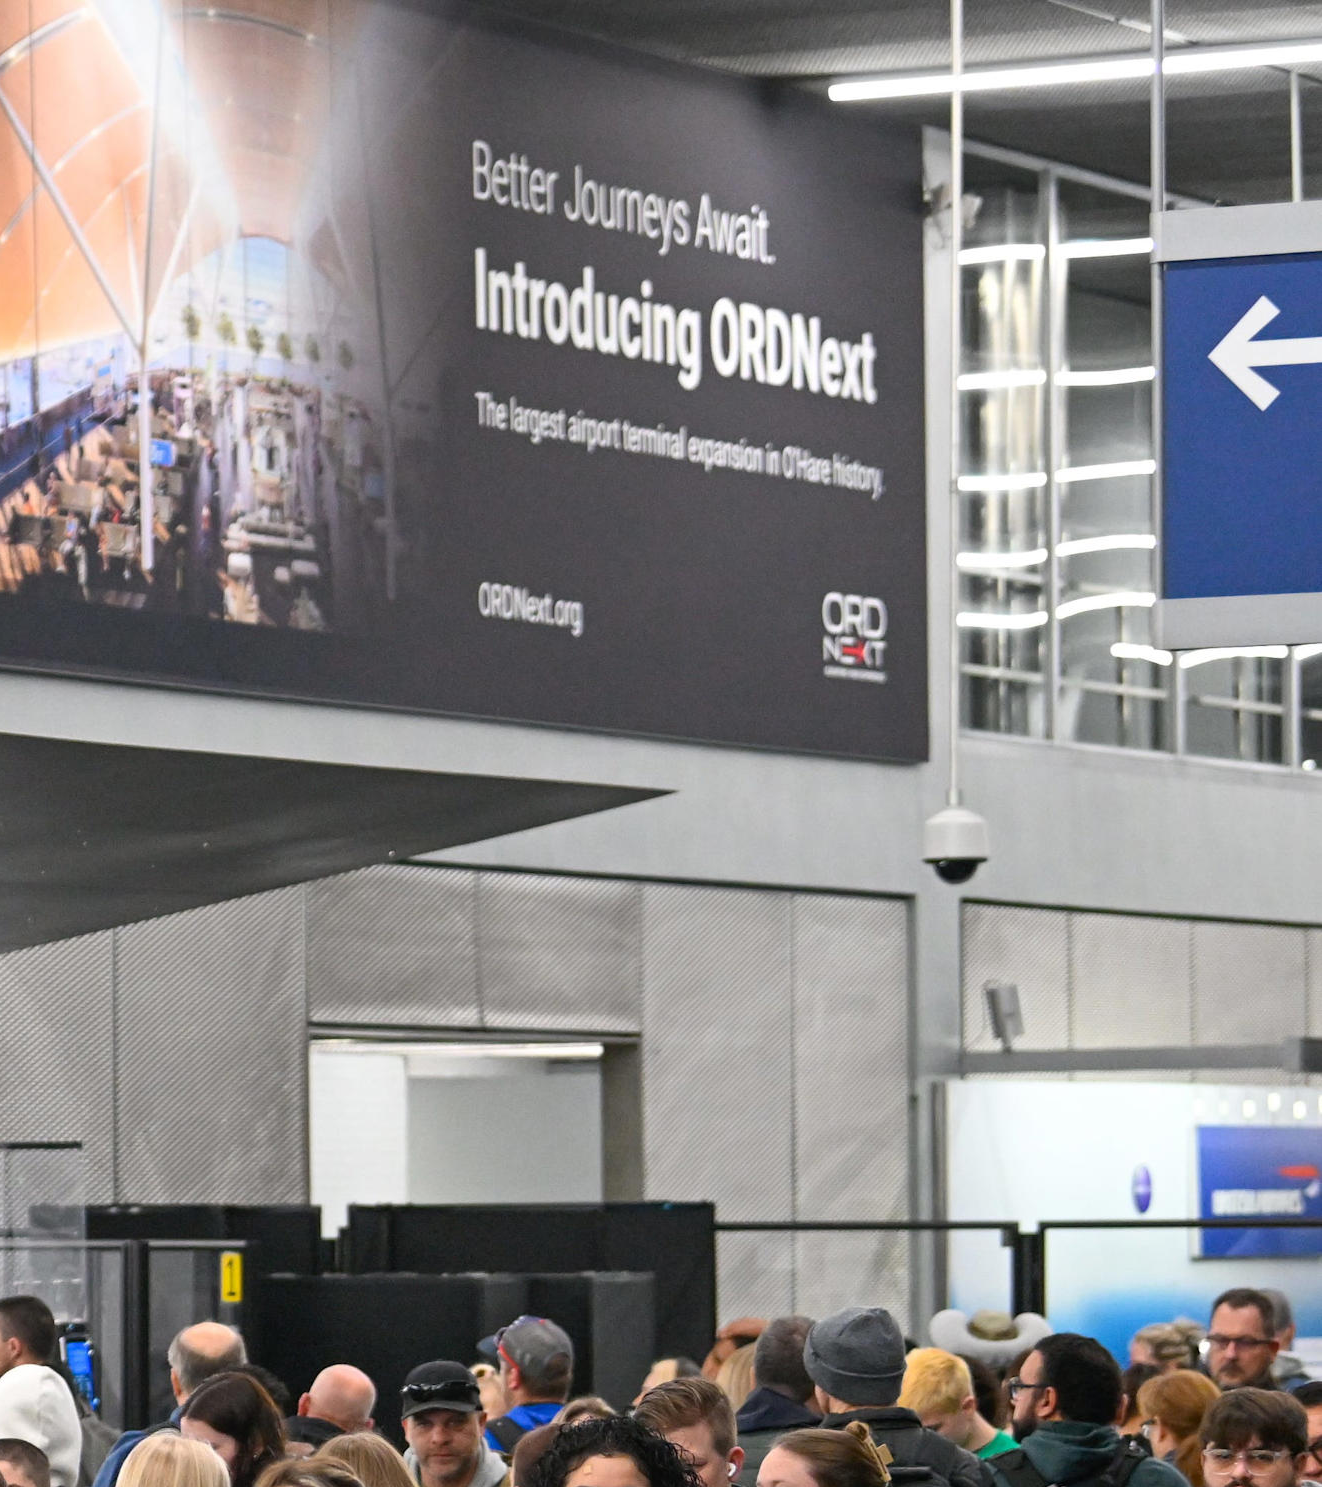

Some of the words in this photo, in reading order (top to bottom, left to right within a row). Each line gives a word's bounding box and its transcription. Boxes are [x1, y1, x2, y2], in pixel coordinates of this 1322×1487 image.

[472, 140, 559, 215] Better
[564, 164, 690, 256] Journeys
[694, 193, 777, 265] Await.
[475, 247, 703, 391] Introducing
[710, 297, 879, 404] ORDNext
[474, 391, 508, 430] The
[509, 395, 566, 444] largest
[567, 409, 622, 453] airport
[622, 419, 688, 460] terminal
[688, 436, 765, 473] expansion
[765, 442, 781, 477] in
[781, 444, 832, 486] O'Hare
[478, 581, 585, 638] ORDNext.org
[821, 591, 888, 640] ORD
[822, 635, 887, 668] NEXT
[226, 1258, 237, 1296] 1
